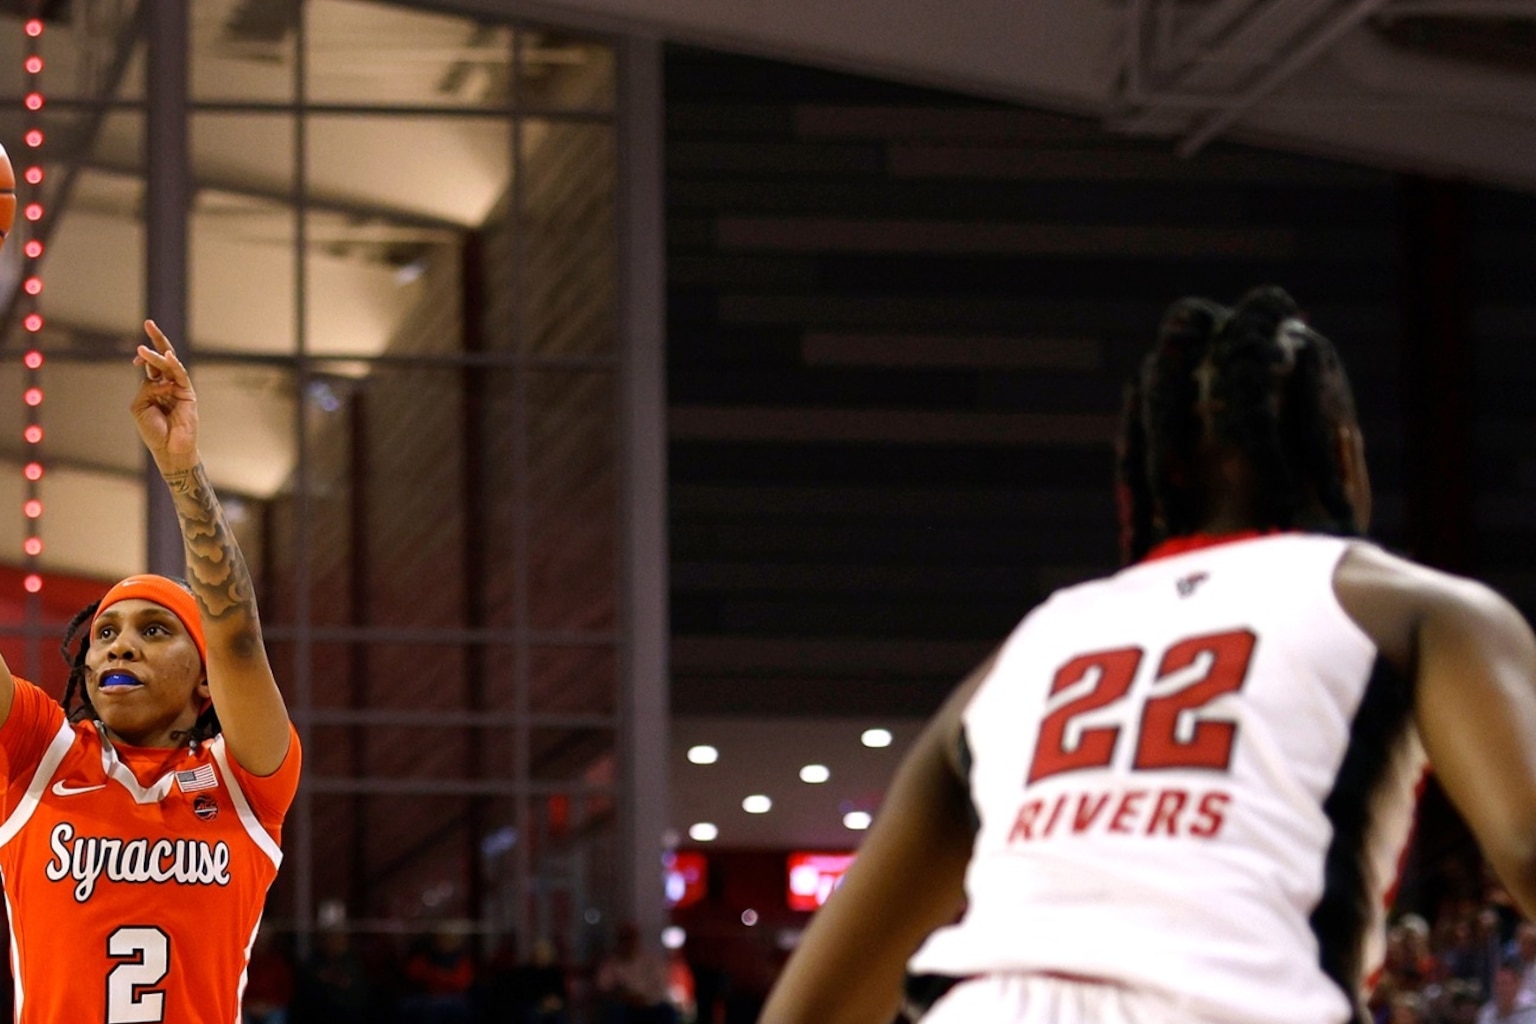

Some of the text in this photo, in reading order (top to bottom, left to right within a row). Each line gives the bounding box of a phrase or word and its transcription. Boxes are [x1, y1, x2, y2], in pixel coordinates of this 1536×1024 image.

[1023, 624, 1260, 789] 22
[1007, 788, 1232, 845] RIVERS
[45, 822, 231, 902] Syracuse
